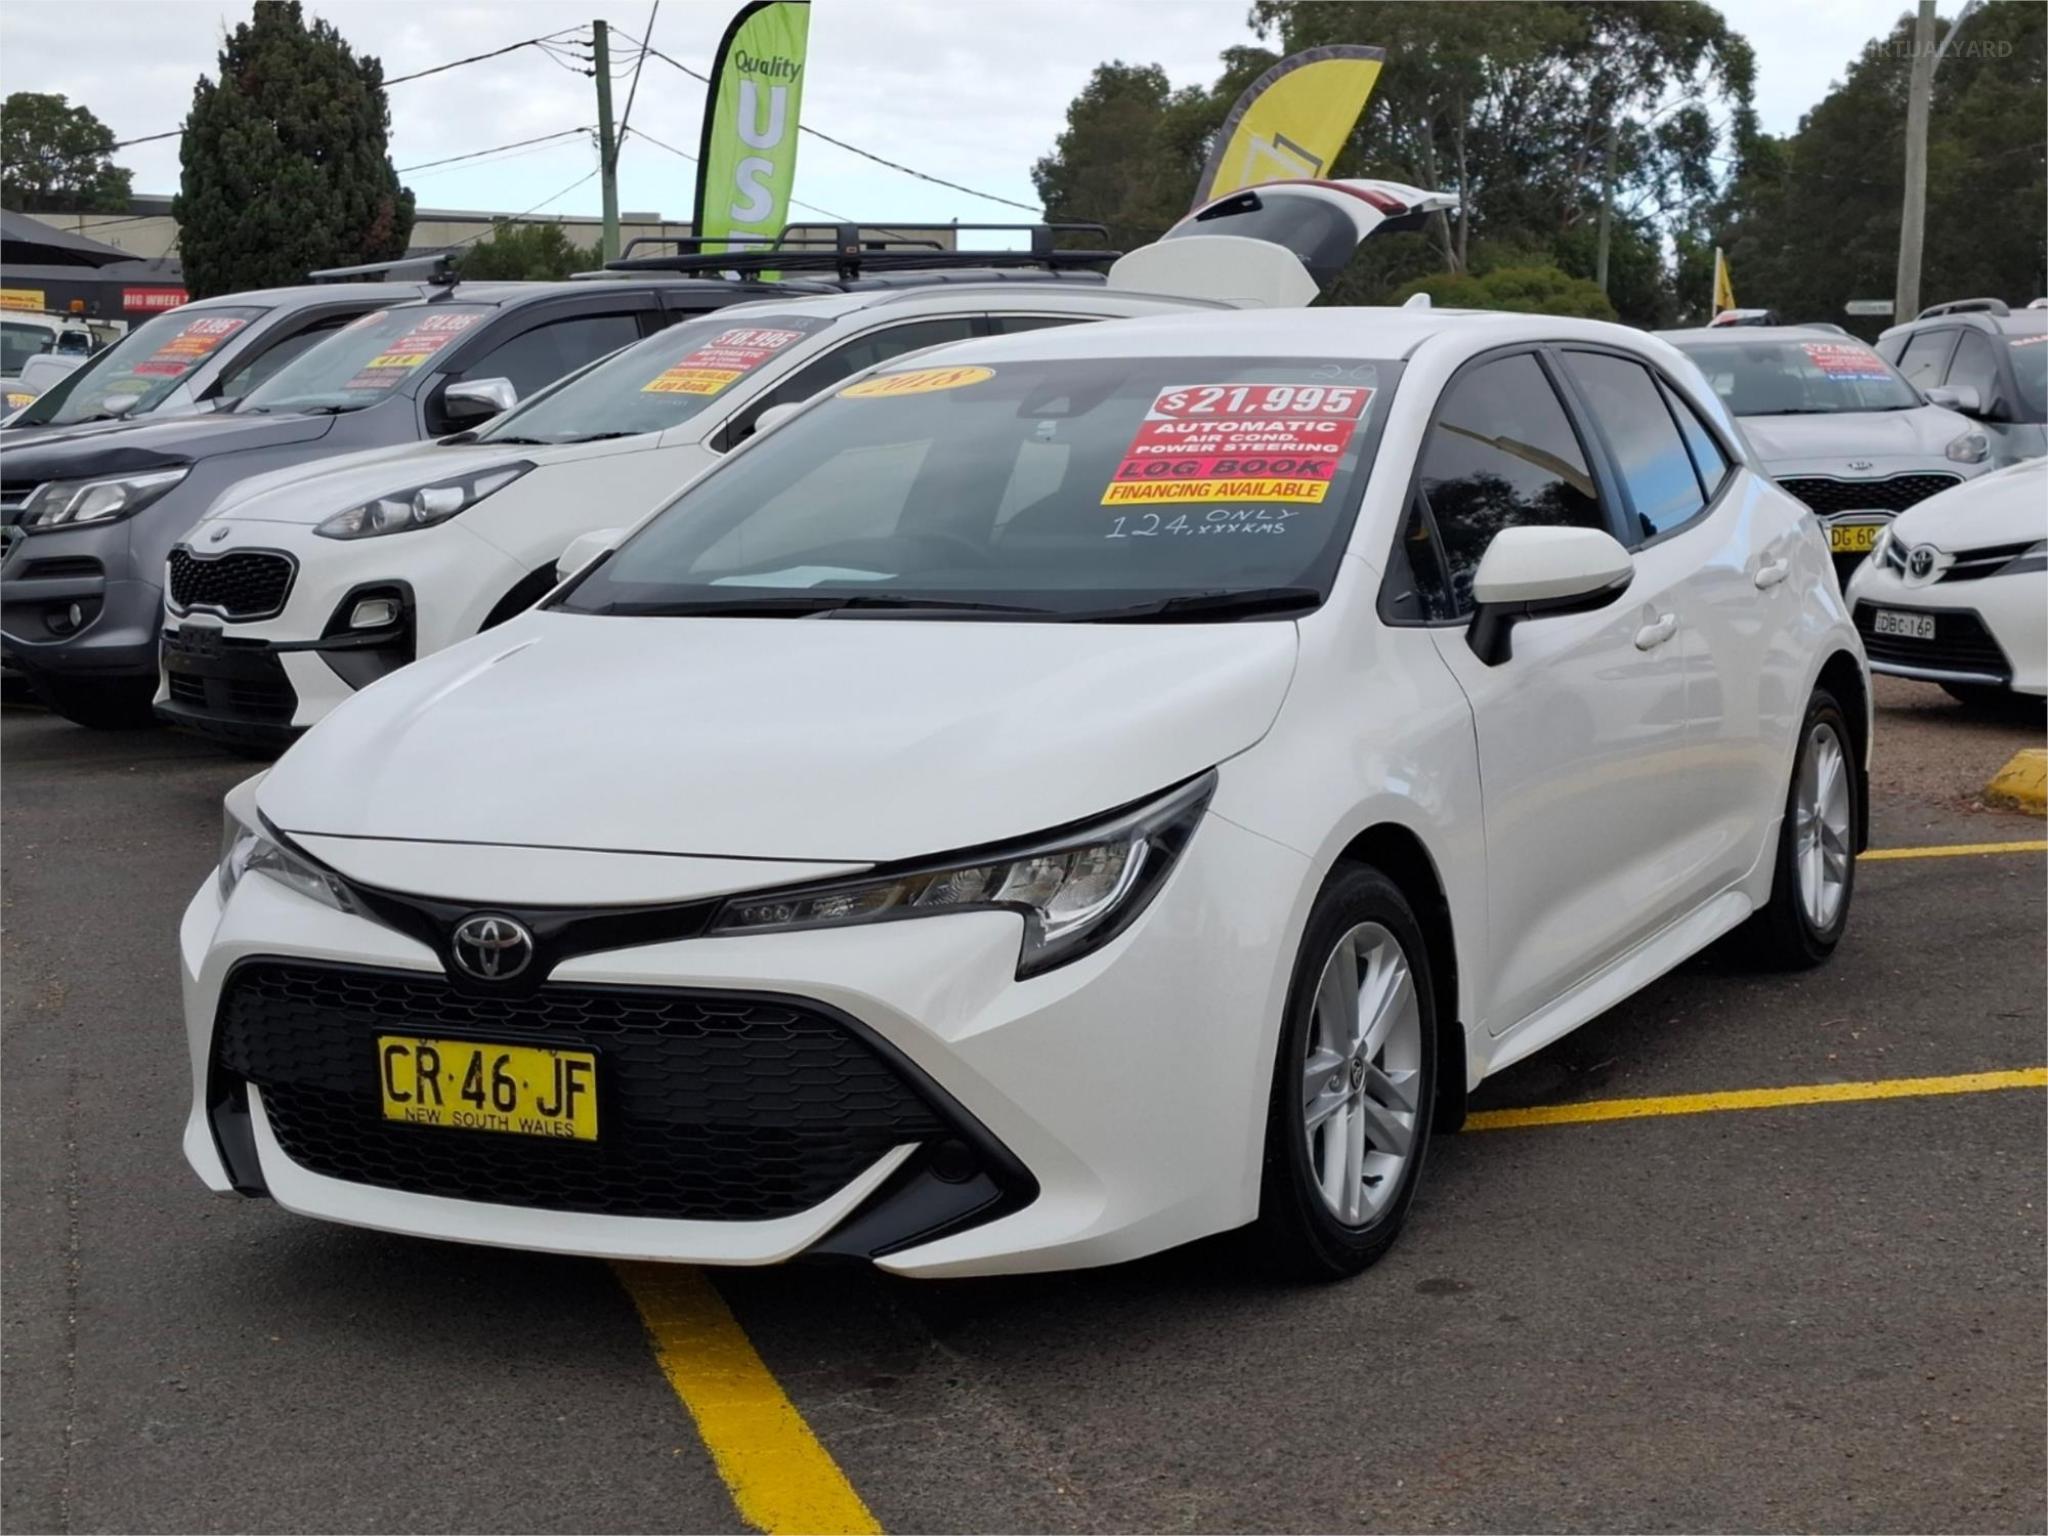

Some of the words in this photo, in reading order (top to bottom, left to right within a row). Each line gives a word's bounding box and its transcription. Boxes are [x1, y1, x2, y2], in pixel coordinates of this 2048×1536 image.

[733, 49, 802, 83] Quality
[123, 294, 143, 305] BIG
[1163, 386, 1357, 414] $21,995
[1153, 420, 1338, 435] AUTOMATIC
[1183, 434, 1217, 443] AIR
[1222, 433, 1299, 443] COND.
[1135, 444, 1217, 454] POWER
[1222, 443, 1339, 453] STEERING
[1117, 461, 1200, 478] LOG
[1209, 459, 1331, 476] BOOK
[1109, 482, 1211, 500] FINANCING
[1217, 482, 1322, 498] AVAILABLE
[1206, 509, 1299, 522] ONLY
[405, 1107, 441, 1123] NEW
[452, 1111, 509, 1131] SOUTH
[518, 1118, 575, 1138] WALES
